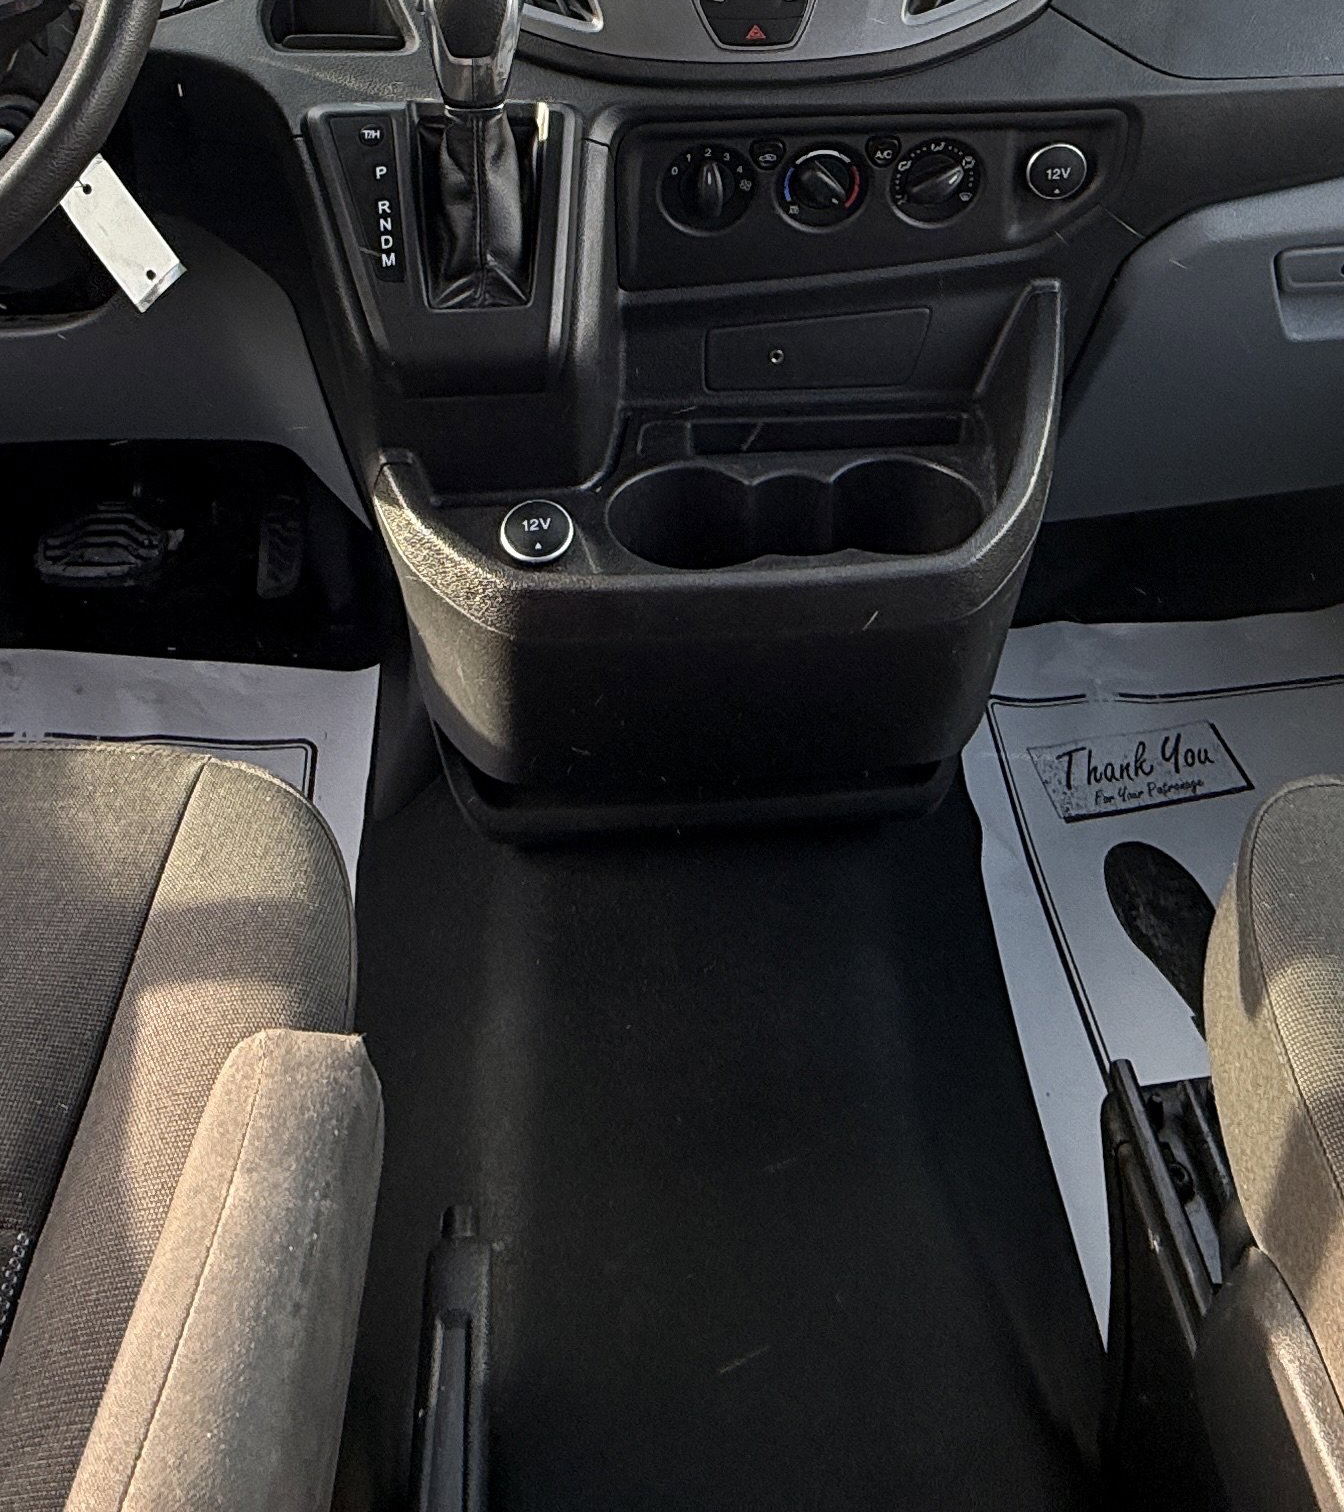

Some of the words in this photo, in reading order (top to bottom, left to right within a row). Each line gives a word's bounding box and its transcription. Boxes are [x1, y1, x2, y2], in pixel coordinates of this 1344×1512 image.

[704, 148, 712, 157] 2
[723, 152, 730, 161] 3
[875, 150, 893, 160] A/C
[375, 165, 387, 180] P
[736, 165, 743, 174] 4
[1046, 167, 1072, 180] 12V
[378, 200, 392, 215] R
[379, 217, 392, 232] N
[380, 235, 394, 250] D
[381, 252, 396, 268] M
[521, 517, 552, 532] 12V
[1056, 740, 1155, 791] Thank
[1160, 732, 1216, 774] You
[1093, 789, 1116, 806] For
[1116, 785, 1145, 804] Your
[1146, 778, 1205, 798] Patronage
